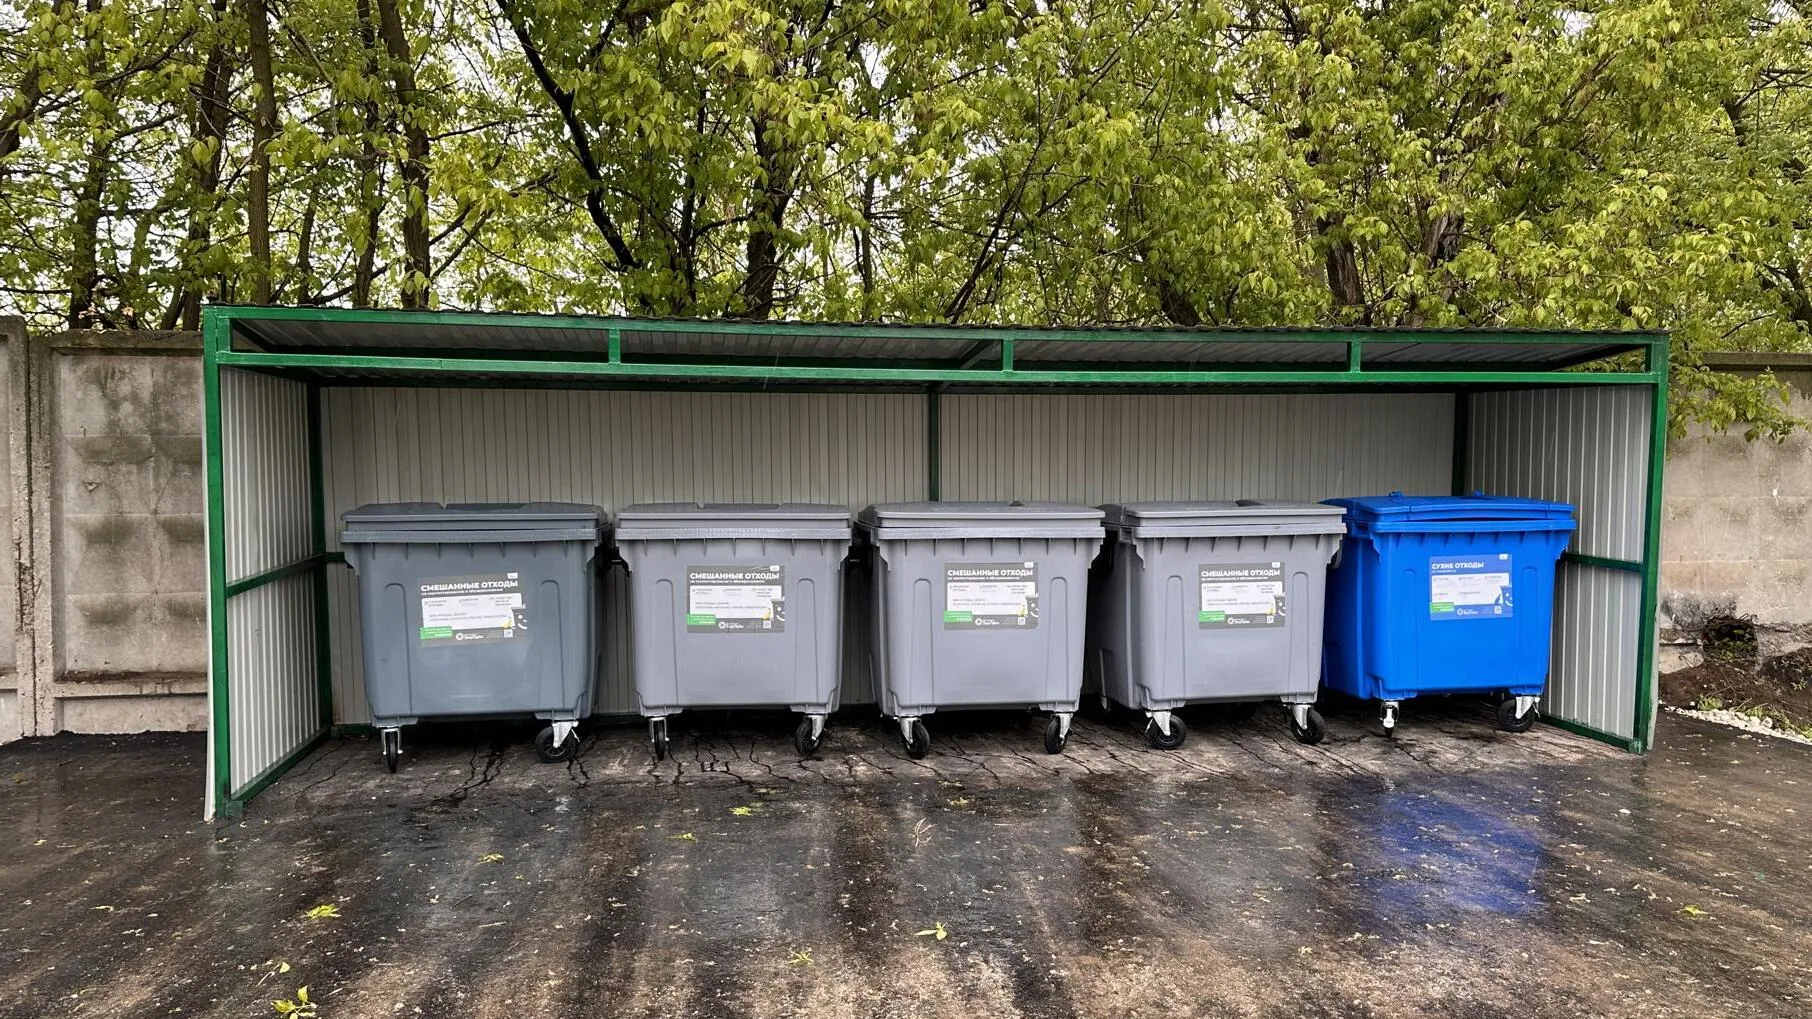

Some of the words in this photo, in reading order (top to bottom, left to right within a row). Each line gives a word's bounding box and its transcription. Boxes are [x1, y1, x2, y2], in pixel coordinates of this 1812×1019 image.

[1454, 561, 1485, 569] ОТХОДЫ
[689, 572, 744, 580] СМЕШАННЫЕ
[745, 572, 780, 581] ОТХОДЫ
[947, 569, 1000, 577] СМЕШАННЫЕ
[1000, 569, 1034, 577] ОТХОДЫ
[1201, 570, 1250, 578] СМЕШАННЫЕ
[1249, 569, 1281, 577] ОТХОДЫ
[421, 582, 480, 592] СМЕШАННЫЕ
[481, 580, 518, 589] ОТХОДЫ
